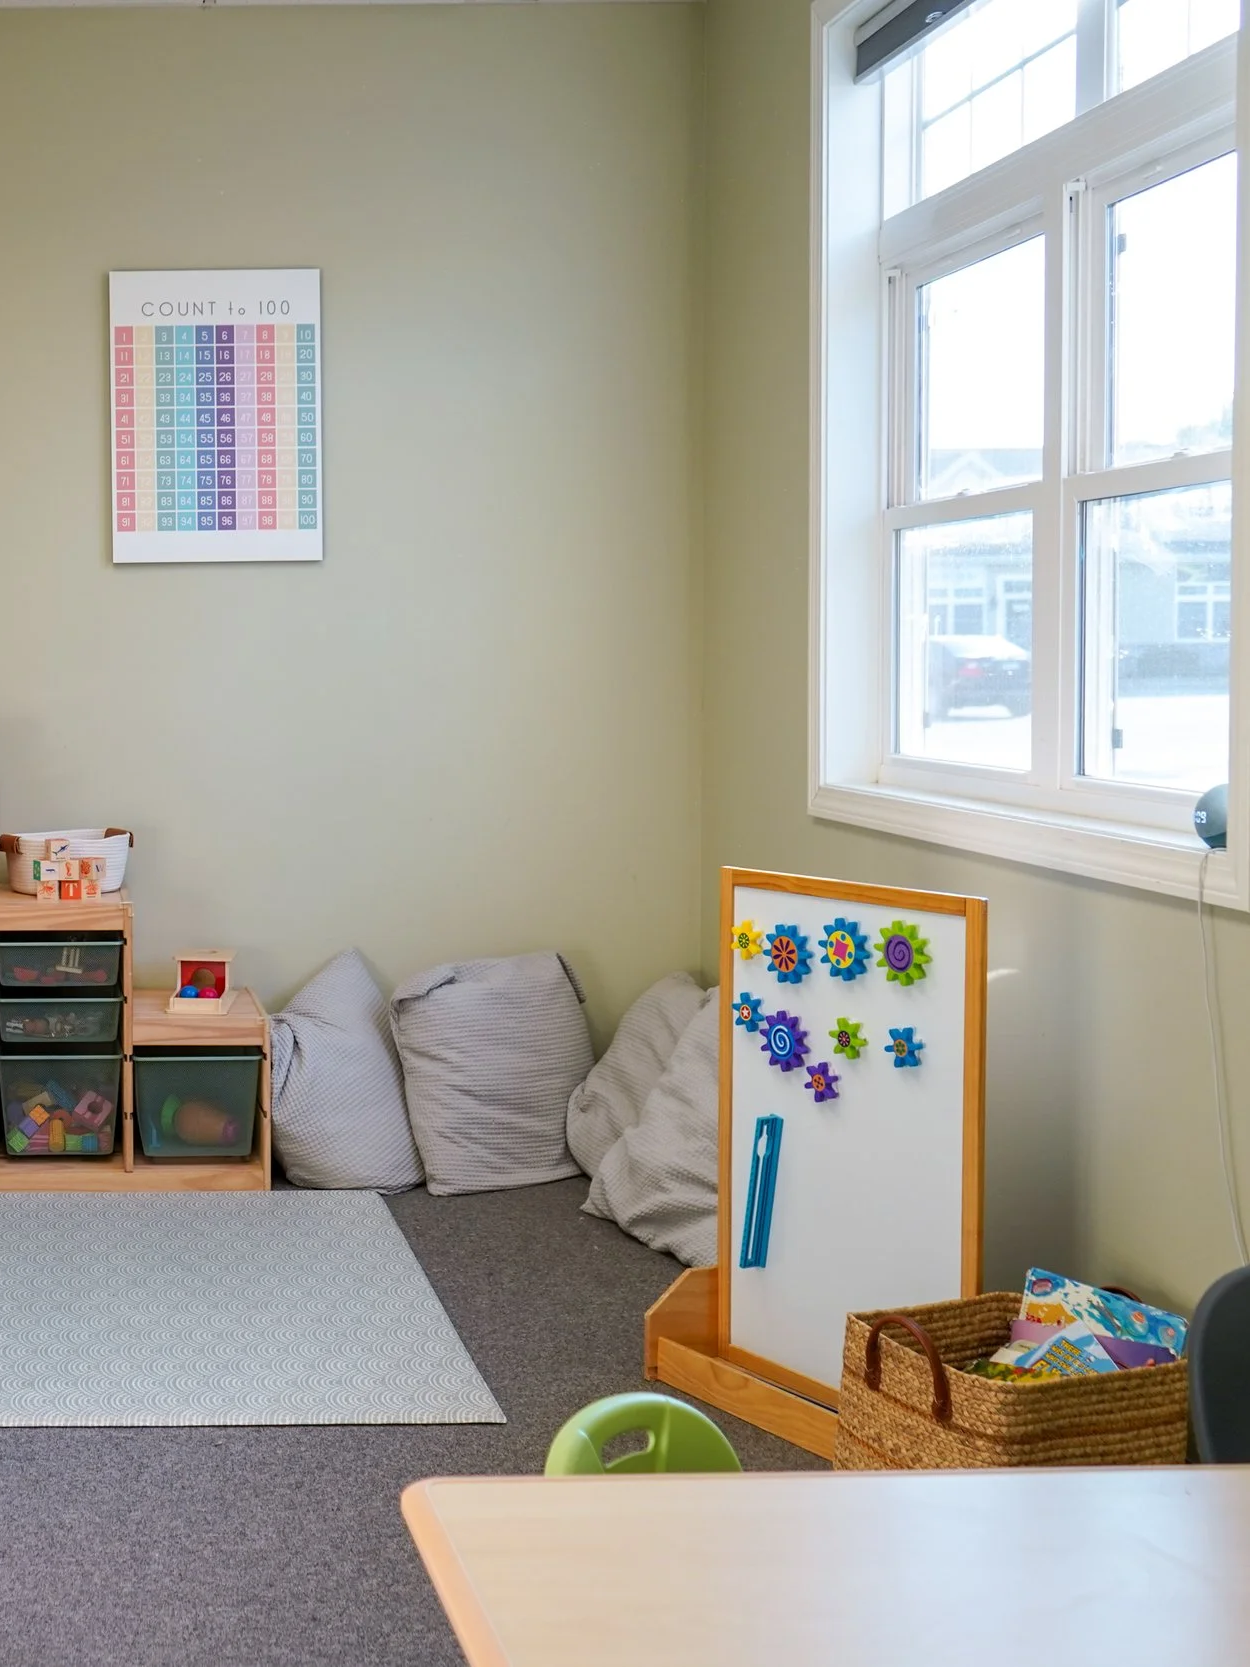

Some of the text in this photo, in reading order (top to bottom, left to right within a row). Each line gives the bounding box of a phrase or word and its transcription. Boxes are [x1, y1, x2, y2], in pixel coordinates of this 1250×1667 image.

[141, 300, 290, 317] COUNT to 100
[300, 330, 311, 340] 10
[121, 351, 128, 361] 11
[160, 351, 170, 361] 13
[199, 350, 211, 361] 15
[219, 350, 230, 360] 16
[260, 350, 271, 360] 18
[300, 349, 313, 359] 20
[120, 373, 130, 383] 21
[159, 373, 171, 383] 23
[198, 372, 212, 382] 25
[219, 372, 231, 382] 26
[260, 372, 273, 381] 28
[300, 371, 313, 381] 30
[121, 394, 129, 403] 31
[159, 393, 171, 403] 33
[200, 392, 212, 402] 35
[220, 392, 231, 402] 36
[261, 392, 272, 402] 38
[300, 391, 312, 401] 40
[121, 415, 129, 424] 41
[160, 414, 170, 423] 43
[199, 414, 211, 424] 45
[220, 413, 231, 423] 46
[261, 413, 271, 422] 48
[301, 412, 314, 422] 50
[121, 435, 131, 445] 51
[160, 434, 172, 444] 53
[200, 434, 214, 444] 55
[220, 433, 232, 443] 56
[262, 433, 274, 443] 58
[300, 432, 313, 442] 60
[121, 456, 129, 466] 61
[159, 456, 171, 465] 63
[200, 455, 213, 464] 65
[220, 454, 231, 464] 66
[261, 454, 273, 464] 68
[301, 453, 313, 463] 70
[121, 476, 130, 486] 71
[161, 476, 172, 486] 73
[200, 475, 213, 485] 75
[220, 475, 232, 485] 76
[262, 475, 272, 484] 78
[301, 474, 313, 484] 80
[122, 497, 130, 507] 81
[161, 496, 172, 506] 83
[200, 496, 213, 506] 85
[221, 496, 232, 506] 86
[261, 495, 273, 505] 88
[301, 495, 314, 505] 90
[122, 518, 130, 527] 91
[161, 517, 173, 527] 93
[201, 516, 213, 526] 95
[222, 516, 233, 526] 96
[262, 516, 273, 526] 98
[300, 514, 315, 525] 100
[65, 882, 78, 897] T
